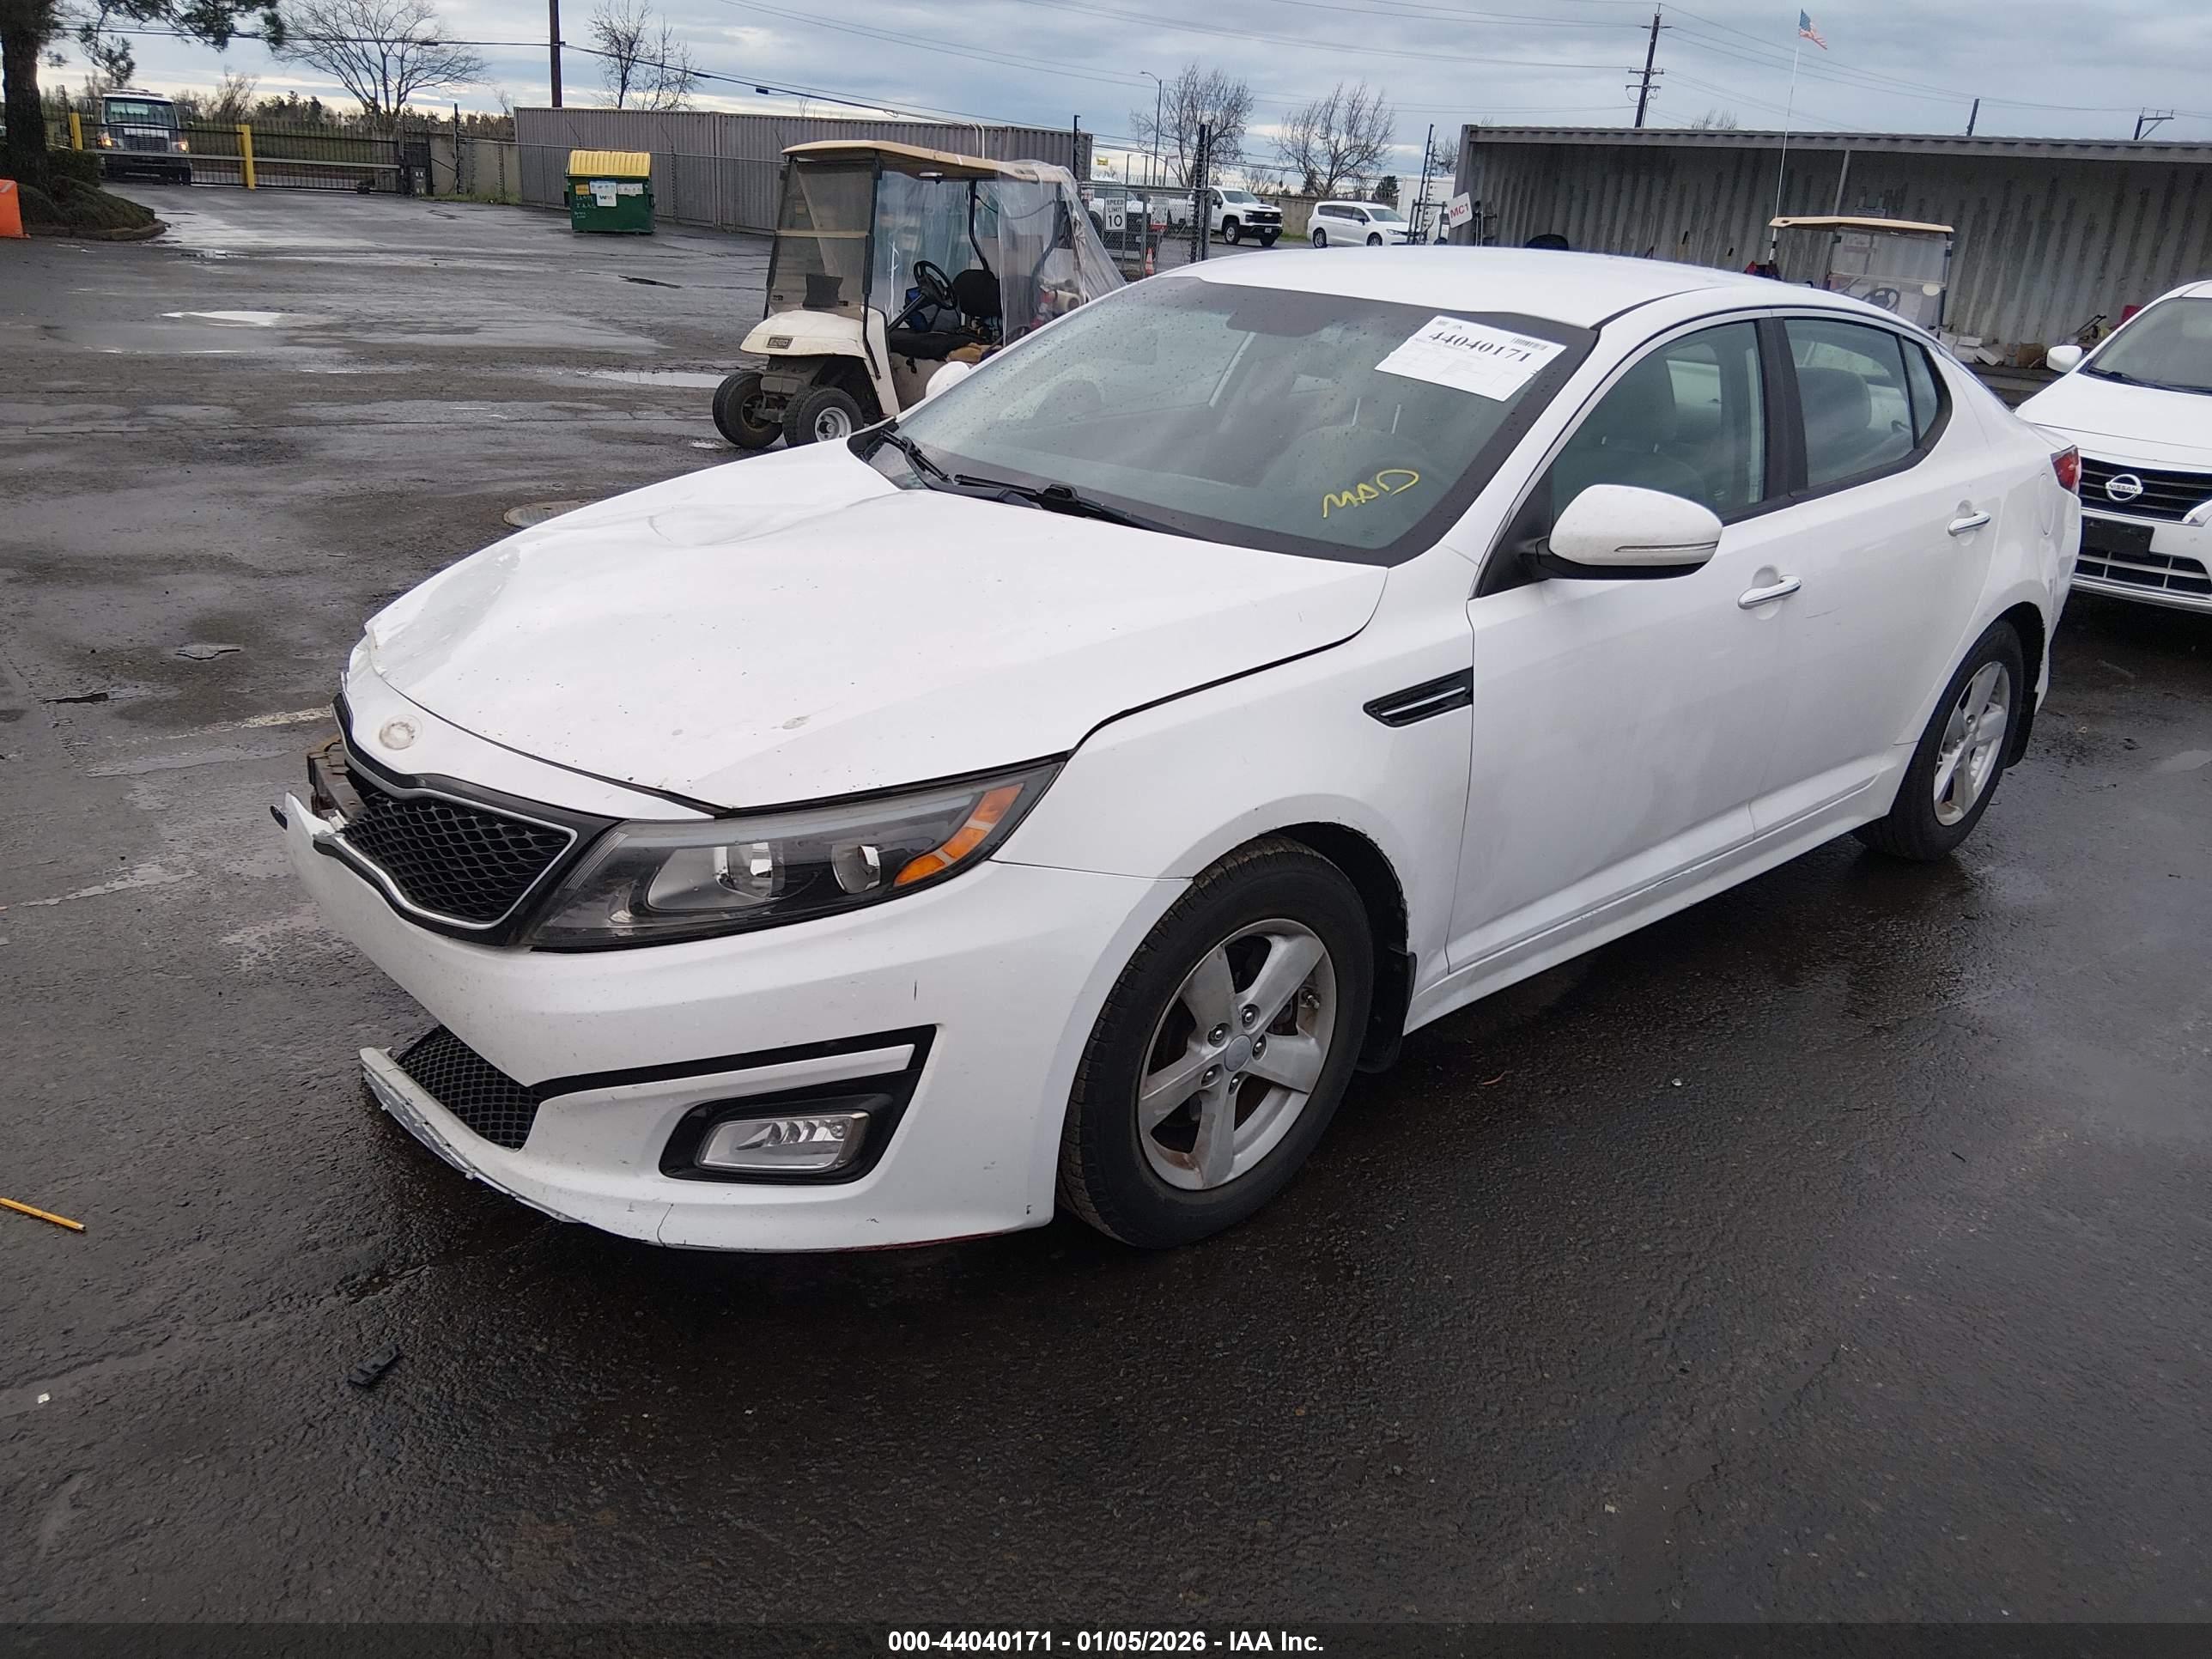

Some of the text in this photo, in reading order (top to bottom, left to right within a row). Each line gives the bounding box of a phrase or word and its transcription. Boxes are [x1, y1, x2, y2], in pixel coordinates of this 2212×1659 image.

[1449, 203, 1469, 219] MC1
[1109, 215, 1122, 227] 10
[1428, 331, 1532, 362] 44040171
[2107, 483, 2138, 492] NISSAN
